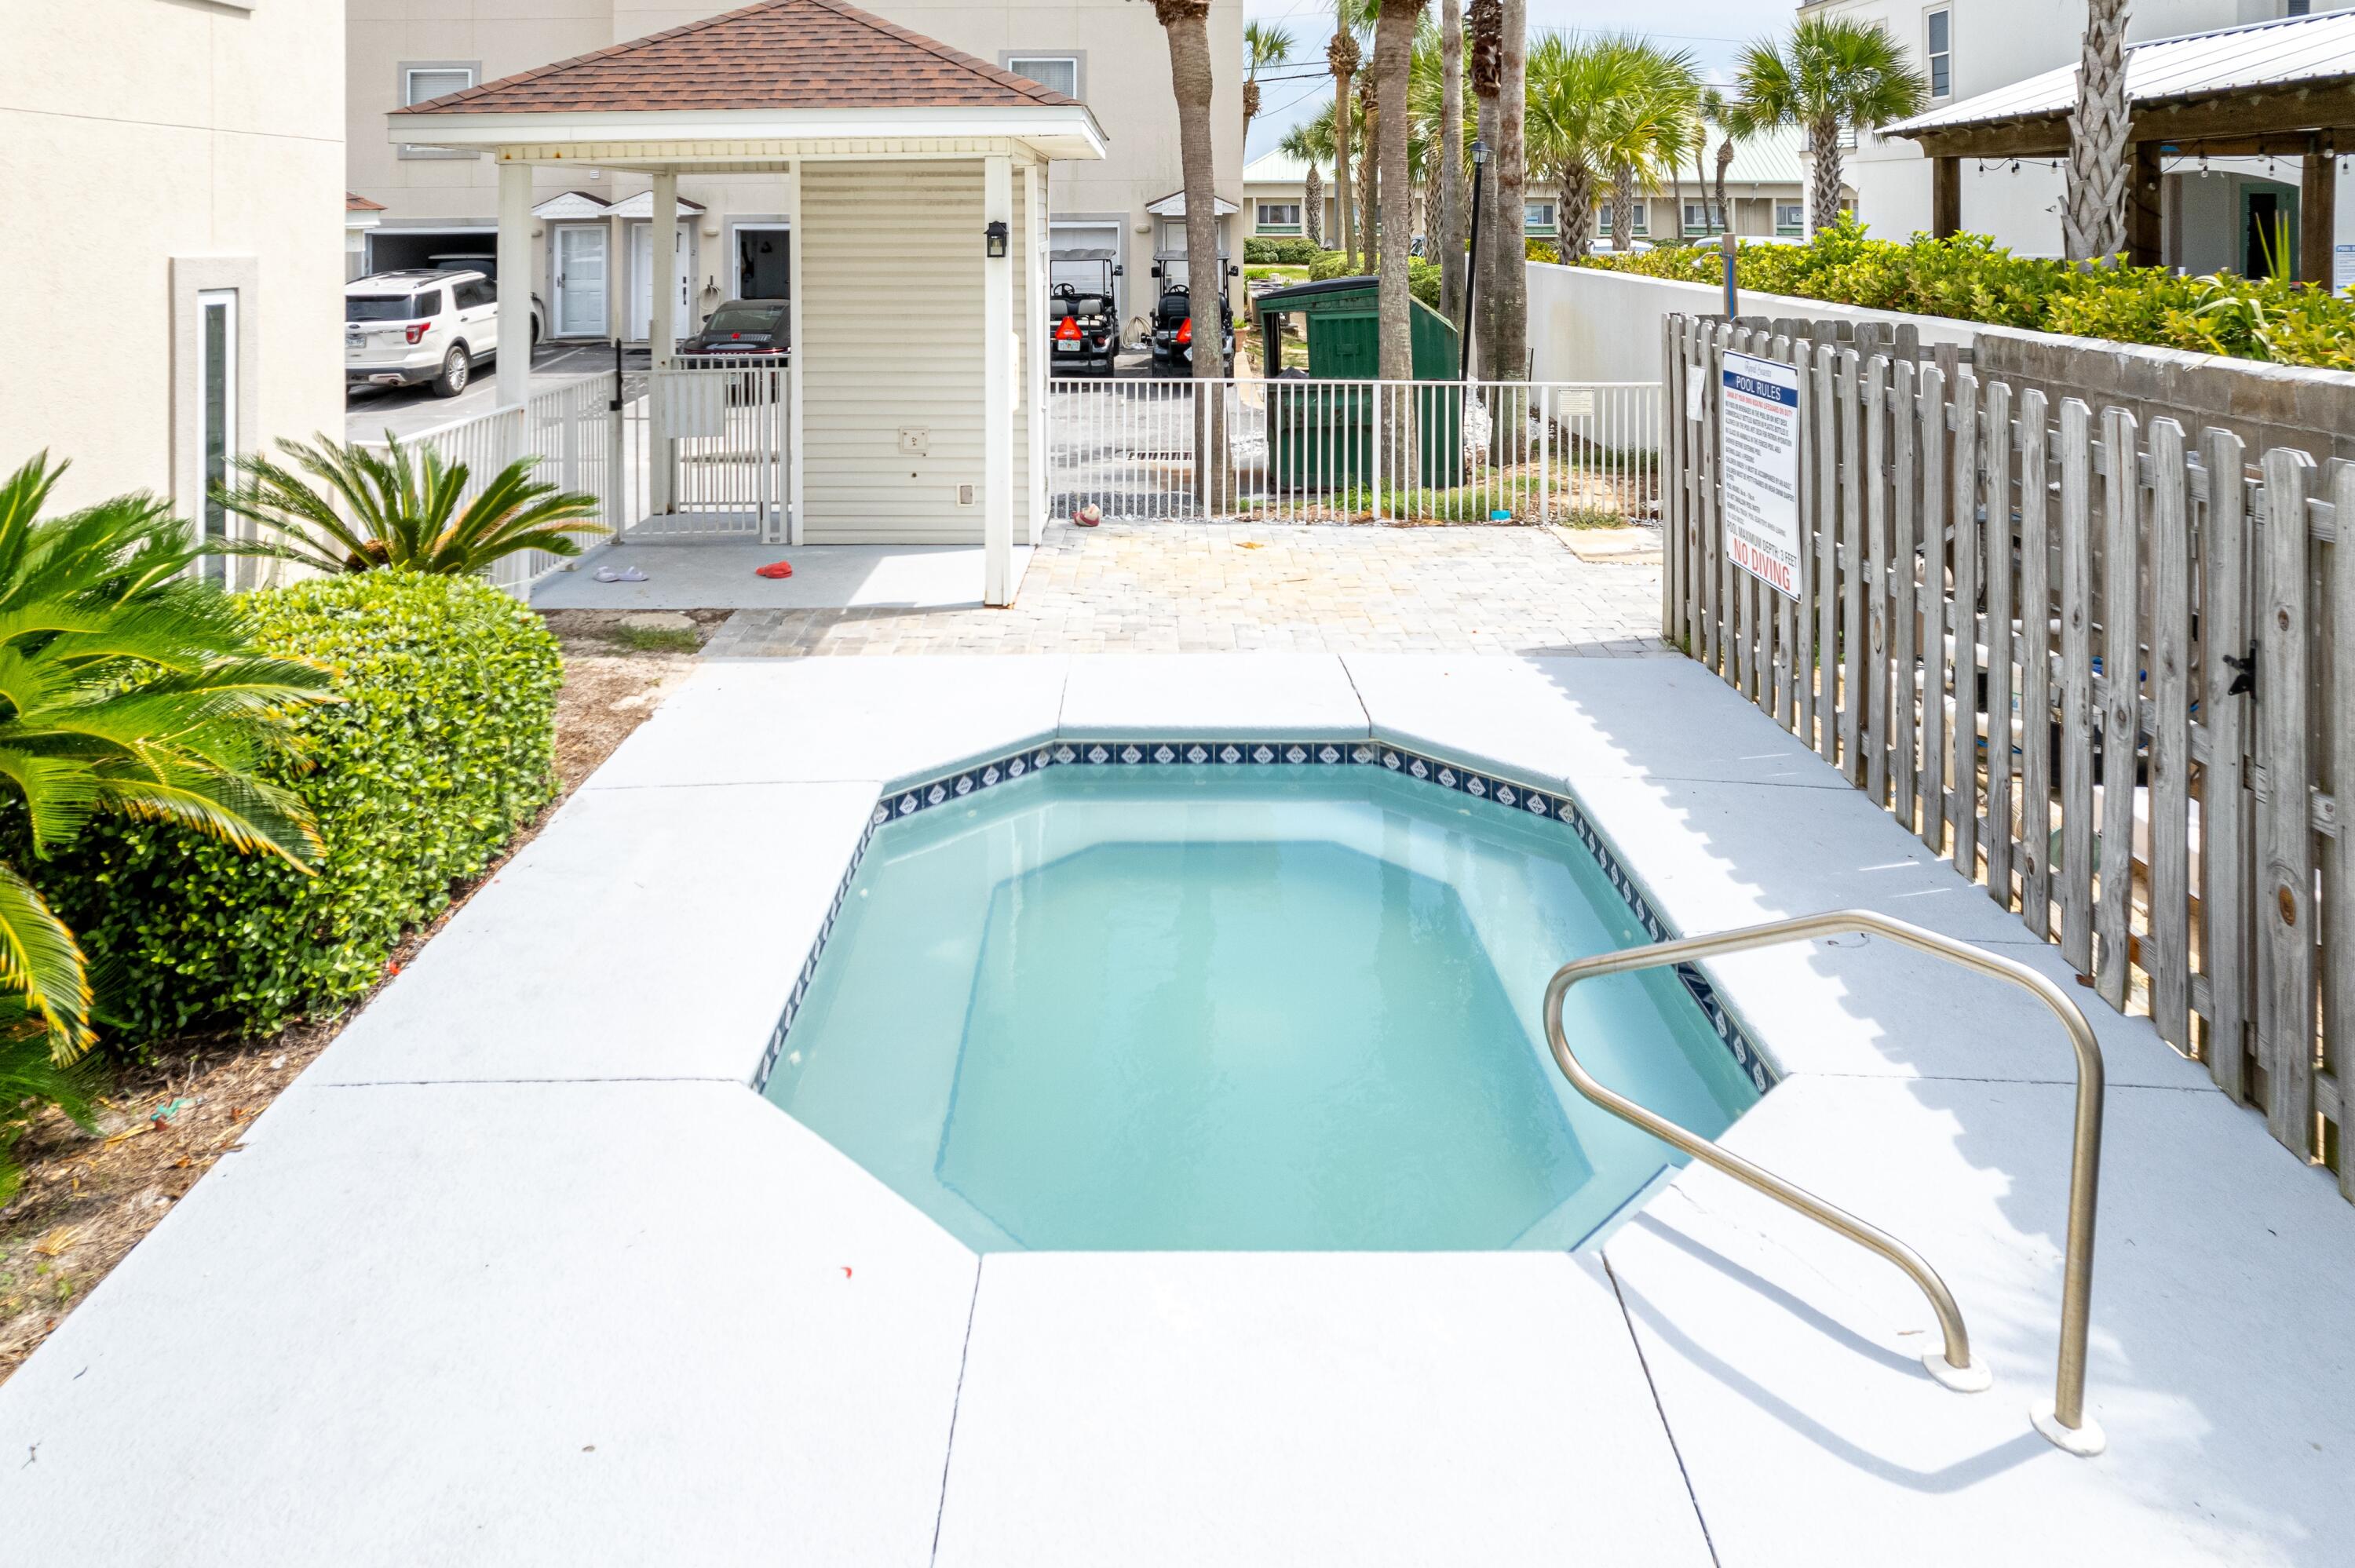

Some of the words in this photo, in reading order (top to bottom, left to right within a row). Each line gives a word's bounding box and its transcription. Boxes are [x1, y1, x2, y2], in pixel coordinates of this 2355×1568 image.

[1736, 376, 1755, 393] POOL
[1757, 381, 1781, 401] RULES
[1727, 520, 1737, 535] POOL
[1739, 527, 1762, 549] MAXIMUM
[1780, 549, 1784, 561] 3
[1785, 552, 1797, 569] FEET
[1734, 538, 1748, 567] NO
[1752, 547, 1790, 592] DIVING
